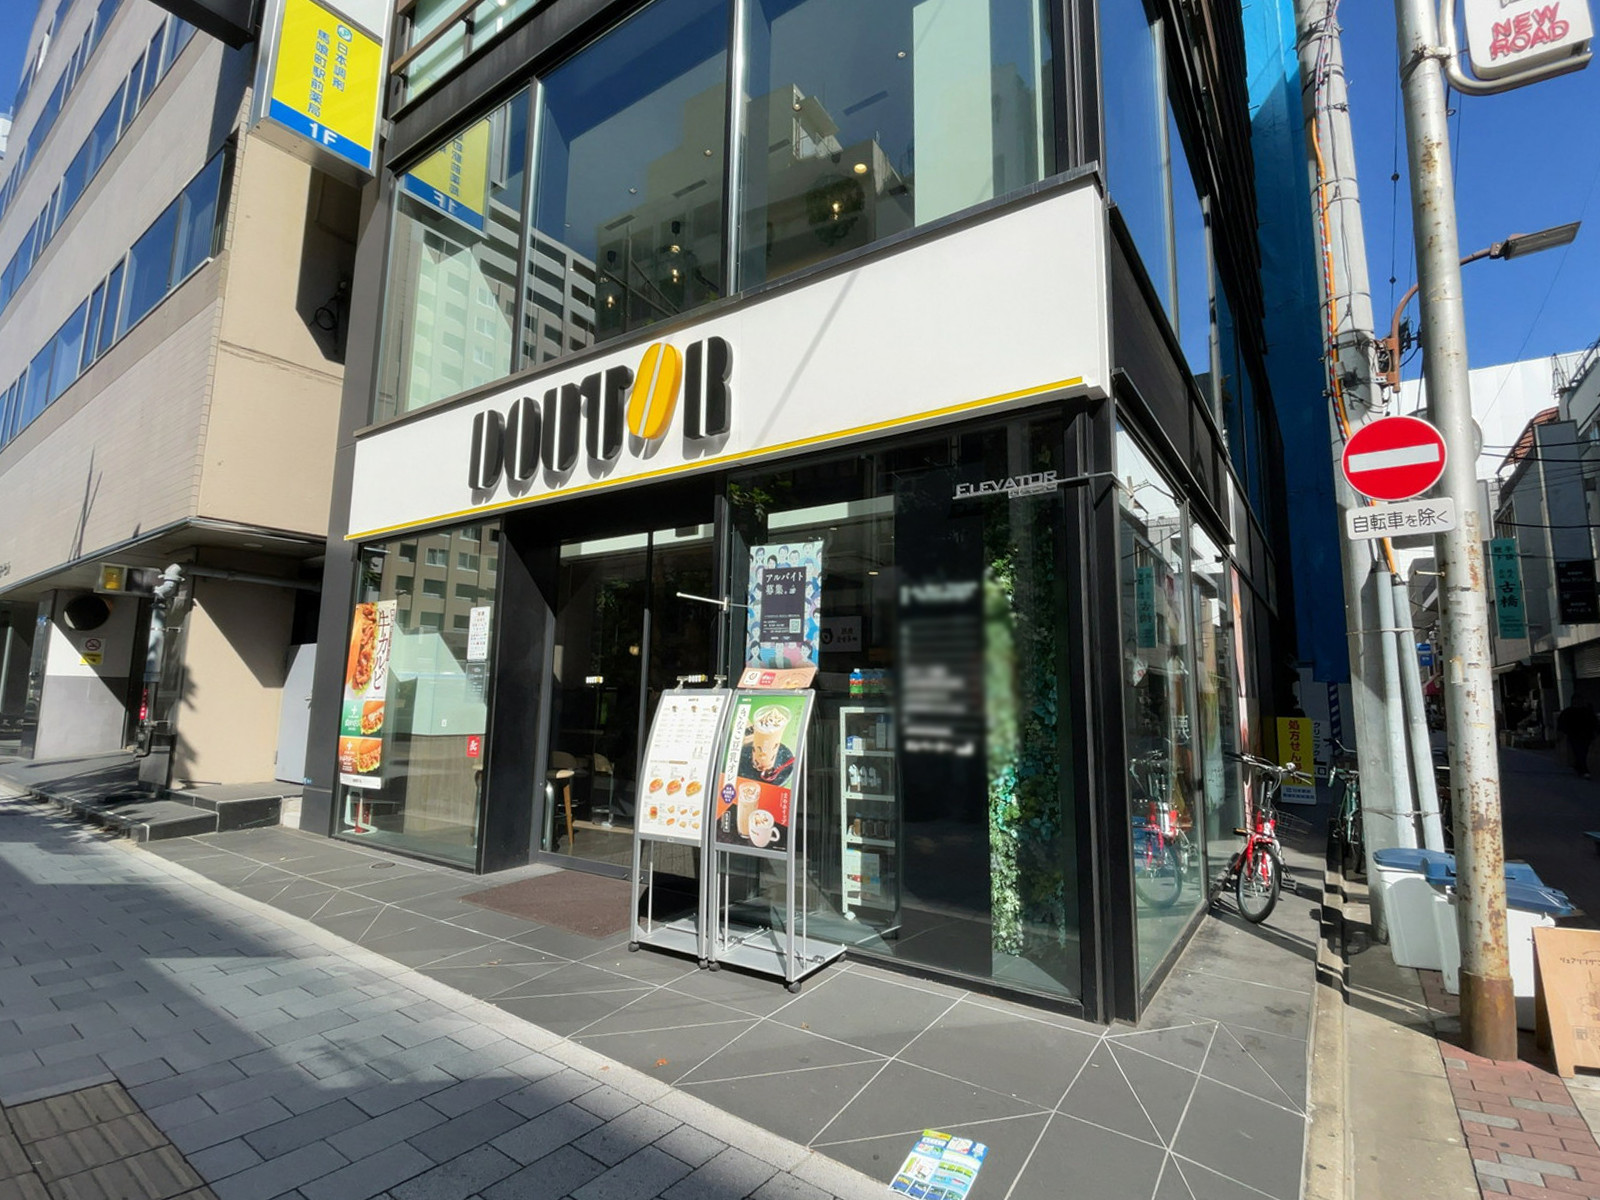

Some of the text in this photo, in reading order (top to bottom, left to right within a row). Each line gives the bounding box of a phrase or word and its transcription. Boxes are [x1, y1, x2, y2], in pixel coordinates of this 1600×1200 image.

[1492, 2, 1560, 38] NEW
[1490, 20, 1570, 60] ROAD
[331, 42, 348, 92] 日本調剤
[309, 122, 338, 145] 1F
[468, 336, 733, 489] DOUTOR
[955, 470, 1057, 498] ELEVATOR
[1354, 508, 1448, 533] 自転車を除く
[766, 571, 804, 583] アルバイト
[373, 609, 390, 689] 牛カルビ
